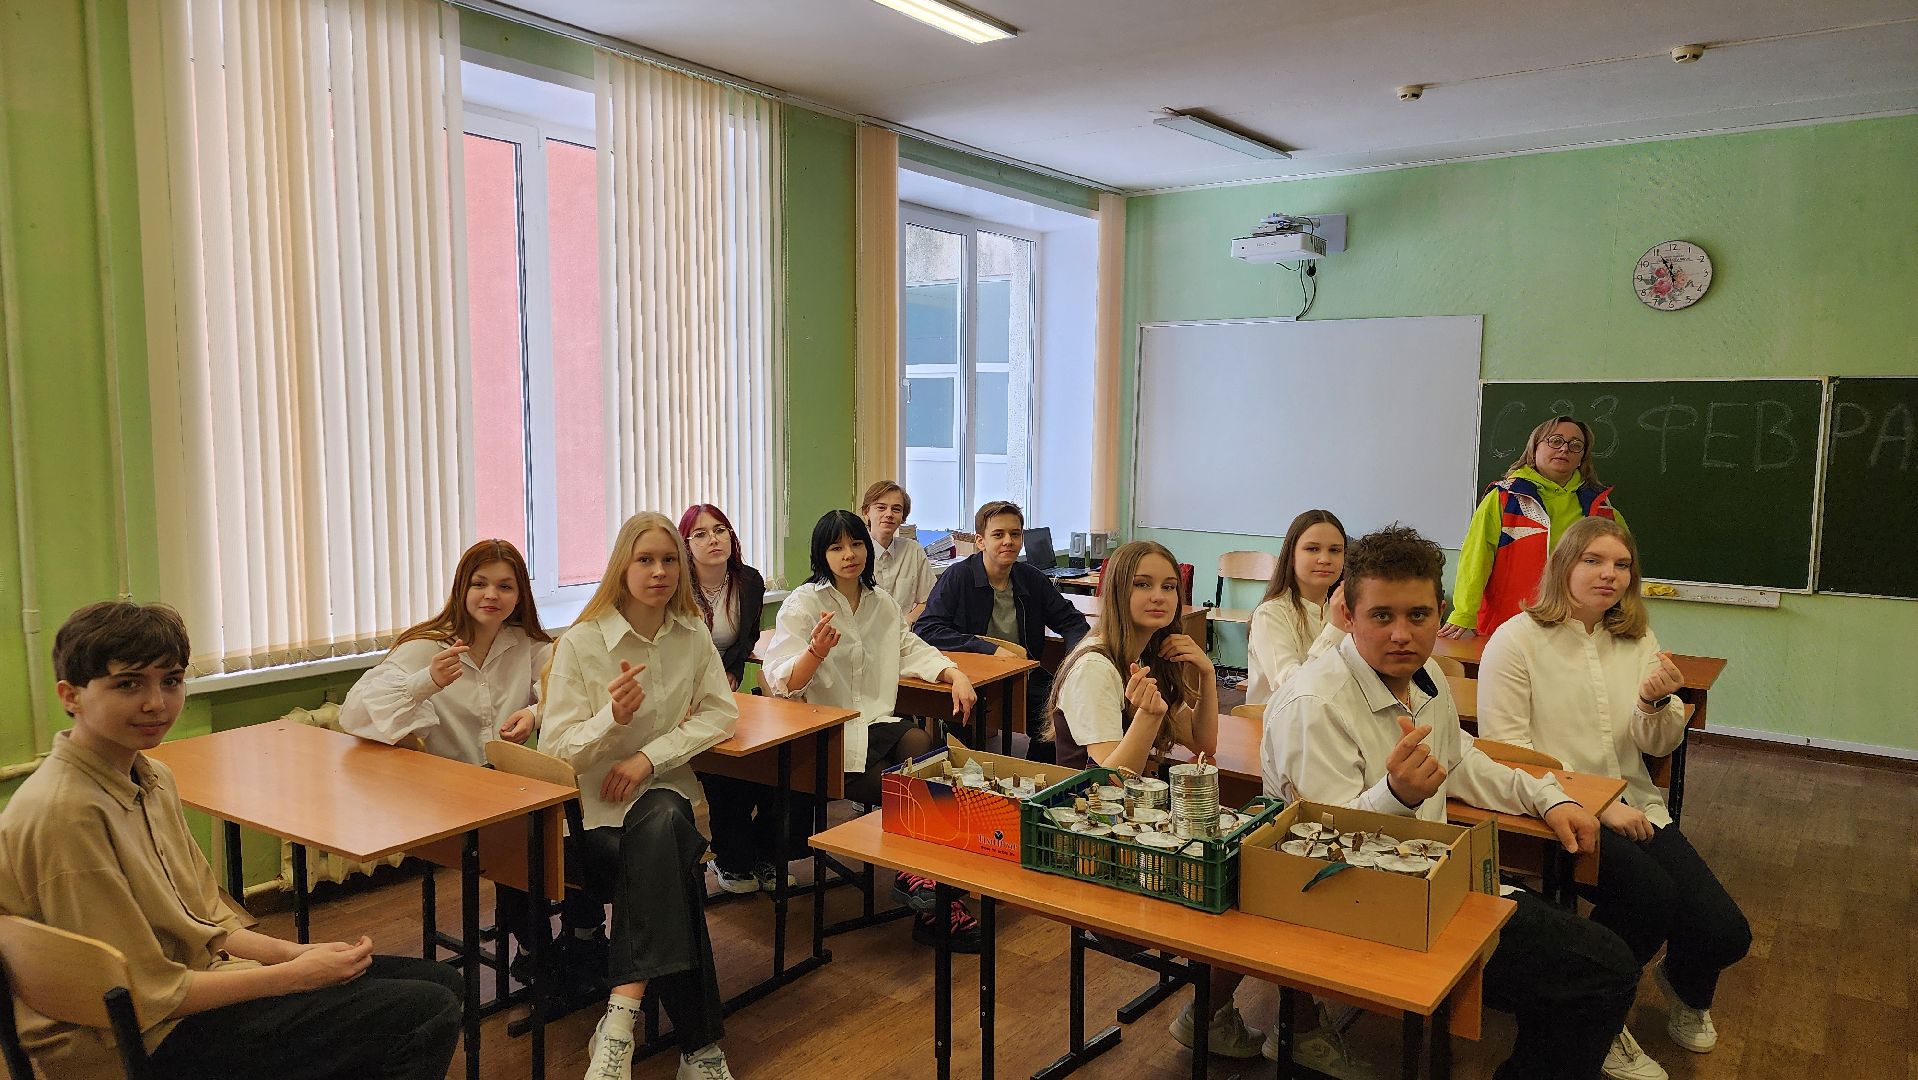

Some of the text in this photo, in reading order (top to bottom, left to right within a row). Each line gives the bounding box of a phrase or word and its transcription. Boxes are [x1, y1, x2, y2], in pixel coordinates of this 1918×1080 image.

[1641, 260, 1650, 268] 10
[1704, 269, 1709, 277] 3
[1697, 284, 1703, 292] 4
[1488, 400, 1526, 459] С
[1549, 394, 1620, 458] 3
